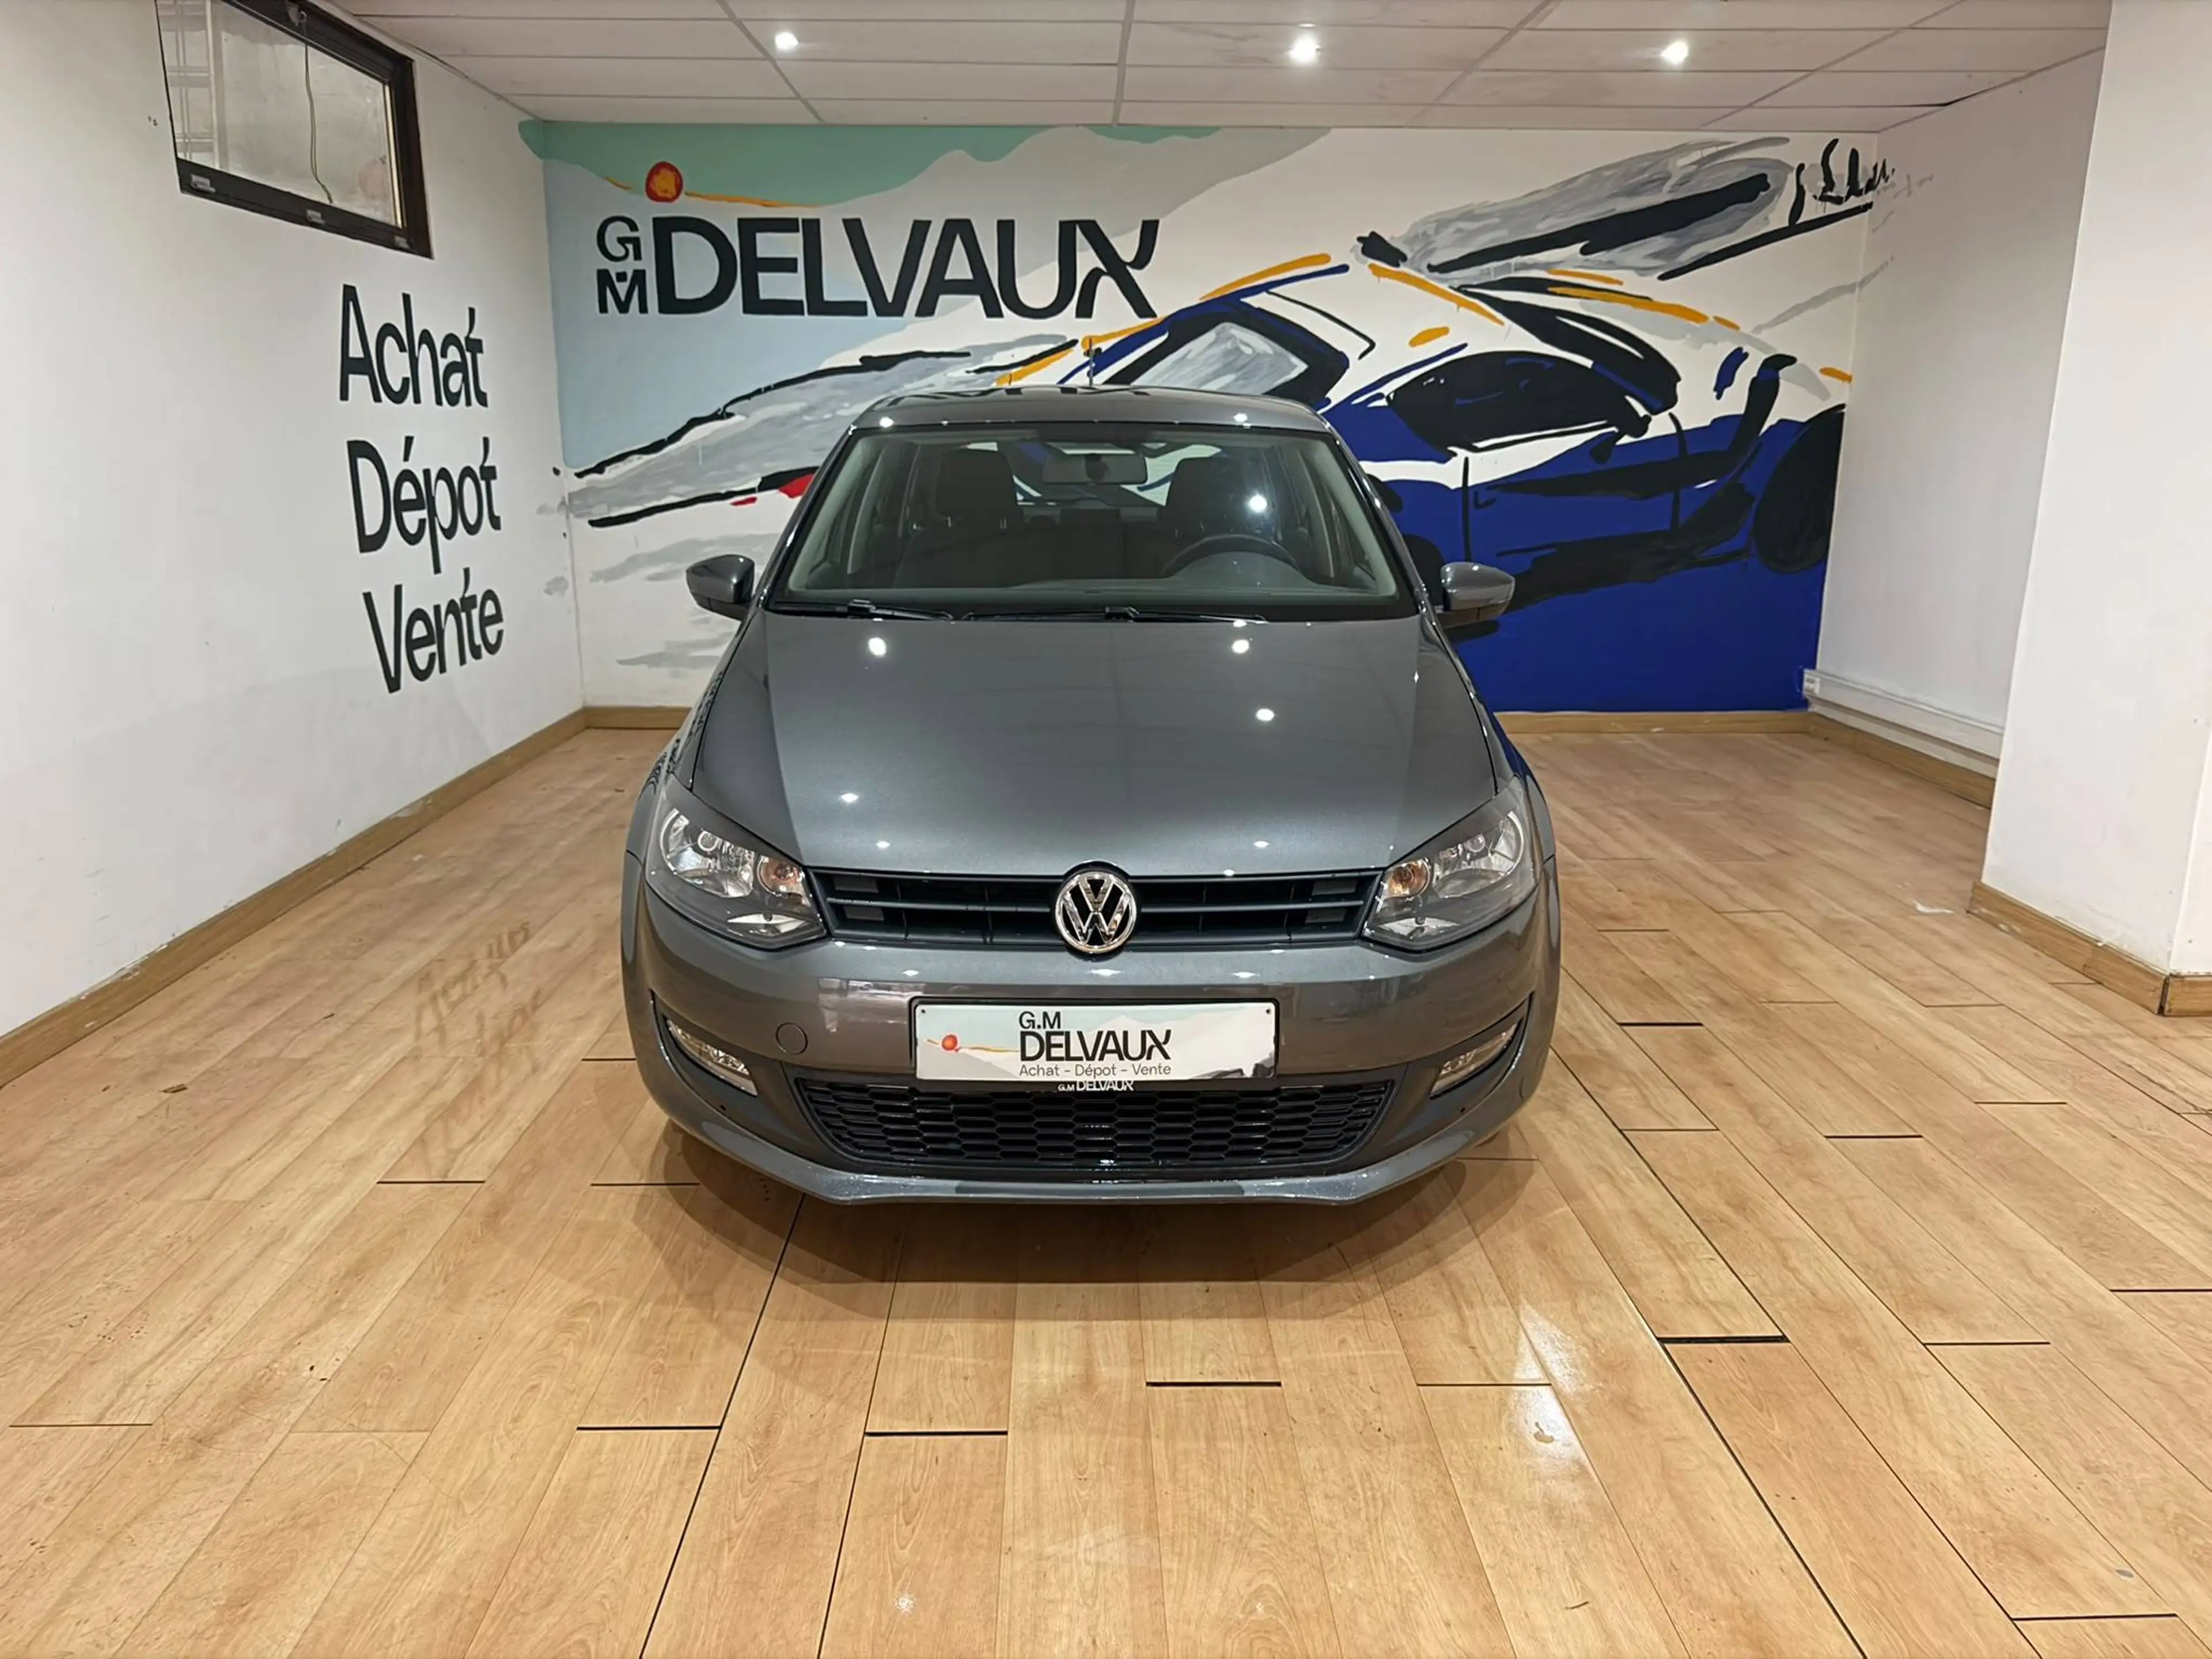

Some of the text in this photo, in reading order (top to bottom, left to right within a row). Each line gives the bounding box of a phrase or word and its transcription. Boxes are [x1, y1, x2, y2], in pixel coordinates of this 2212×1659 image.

[652, 216, 1160, 320] DELVAUX
[339, 283, 488, 408] Achat
[346, 435, 502, 575] Dépot
[362, 567, 505, 694] Vente
[1018, 1011, 1061, 1029] G.M
[1020, 1029, 1172, 1062] DELVAUX
[1019, 1064, 1060, 1077] Achat
[1075, 1063, 1117, 1080] Dépot
[1131, 1063, 1172, 1075] Vente
[1076, 1081, 1134, 1091] DELVAUX
